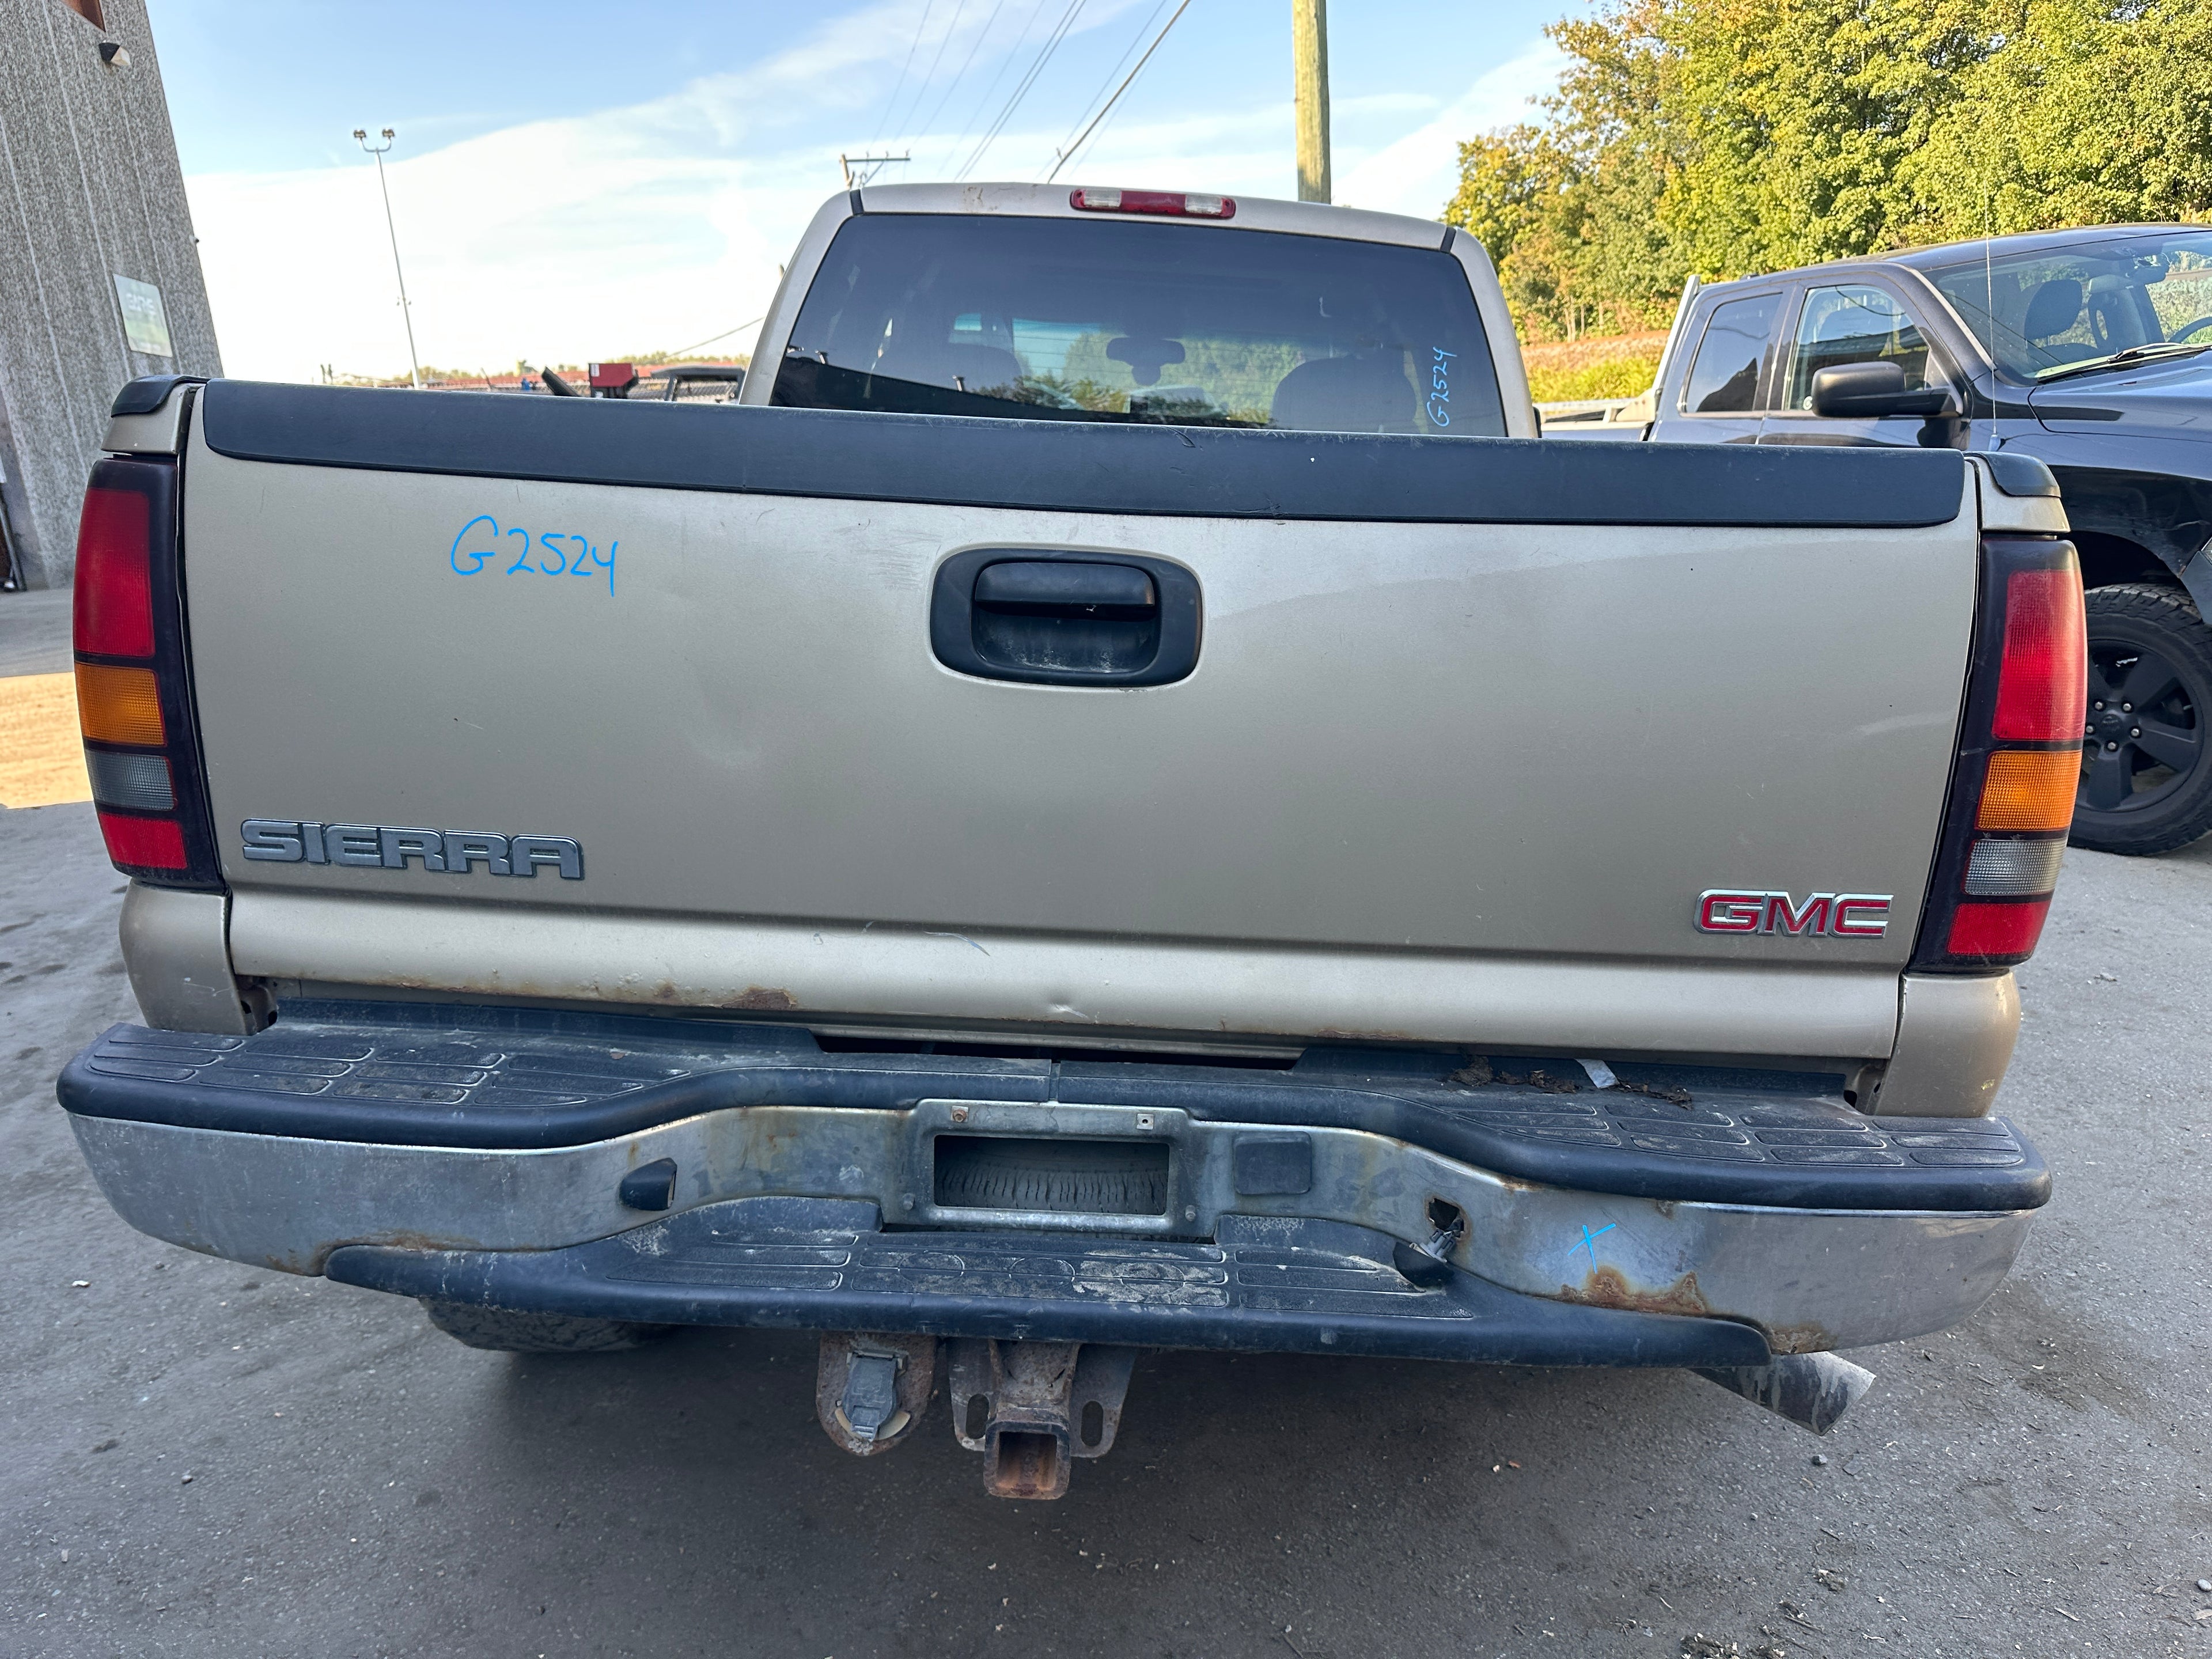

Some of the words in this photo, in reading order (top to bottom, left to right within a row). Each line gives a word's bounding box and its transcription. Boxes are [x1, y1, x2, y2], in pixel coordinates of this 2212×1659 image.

[1426, 346, 1457, 427] G2524
[450, 514, 619, 598] G2524
[240, 817, 585, 881] SIERRA
[1693, 889, 1894, 938] GMC
